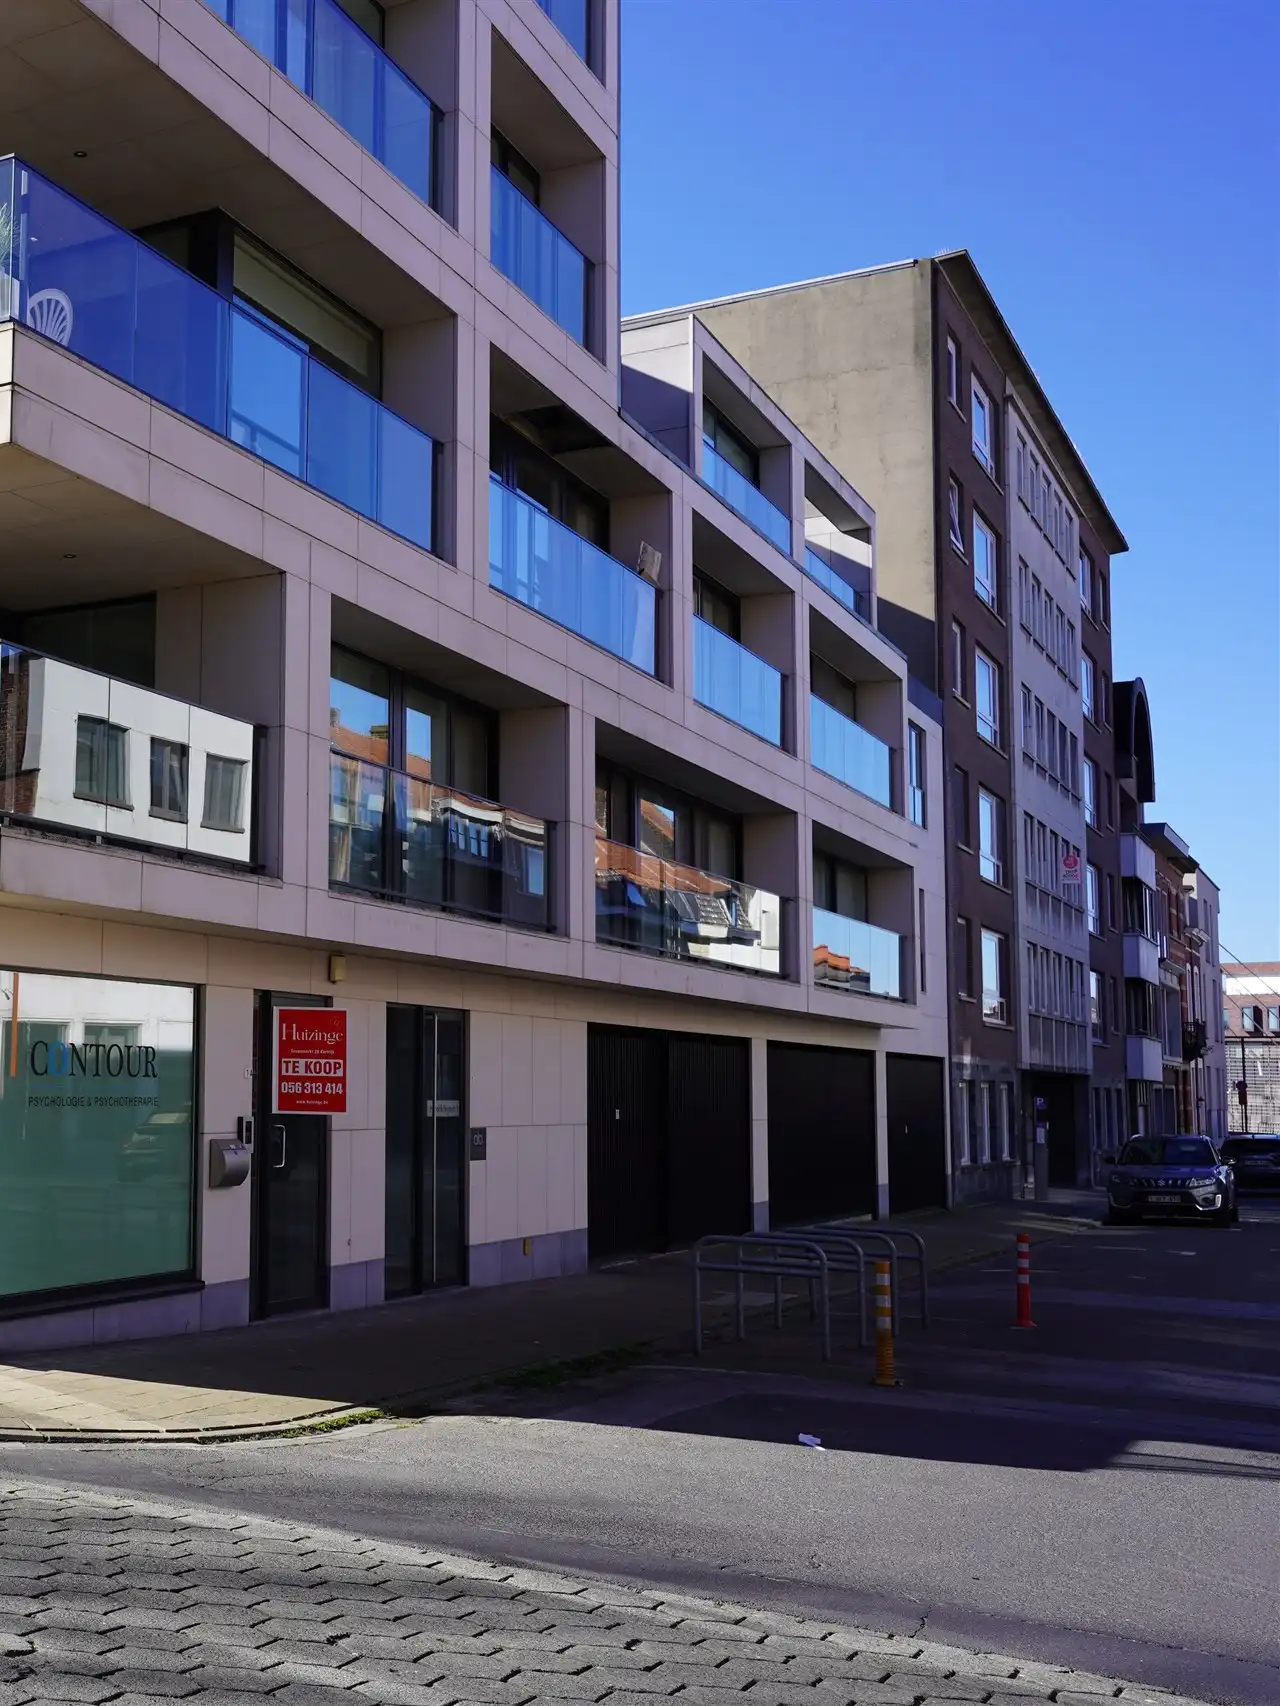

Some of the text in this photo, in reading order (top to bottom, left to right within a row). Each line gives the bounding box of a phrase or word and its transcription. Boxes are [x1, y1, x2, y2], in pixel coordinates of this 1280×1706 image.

[281, 1023, 344, 1045] Huizinge
[30, 1040, 158, 1078] CONTOUR
[283, 1060, 342, 1074] TE KOOP
[281, 1082, 342, 1094] 056 313 414
[29, 1096, 85, 1107] PSYCHOLOGIE
[94, 1096, 158, 1107] PSYCHOTHERAPIE
